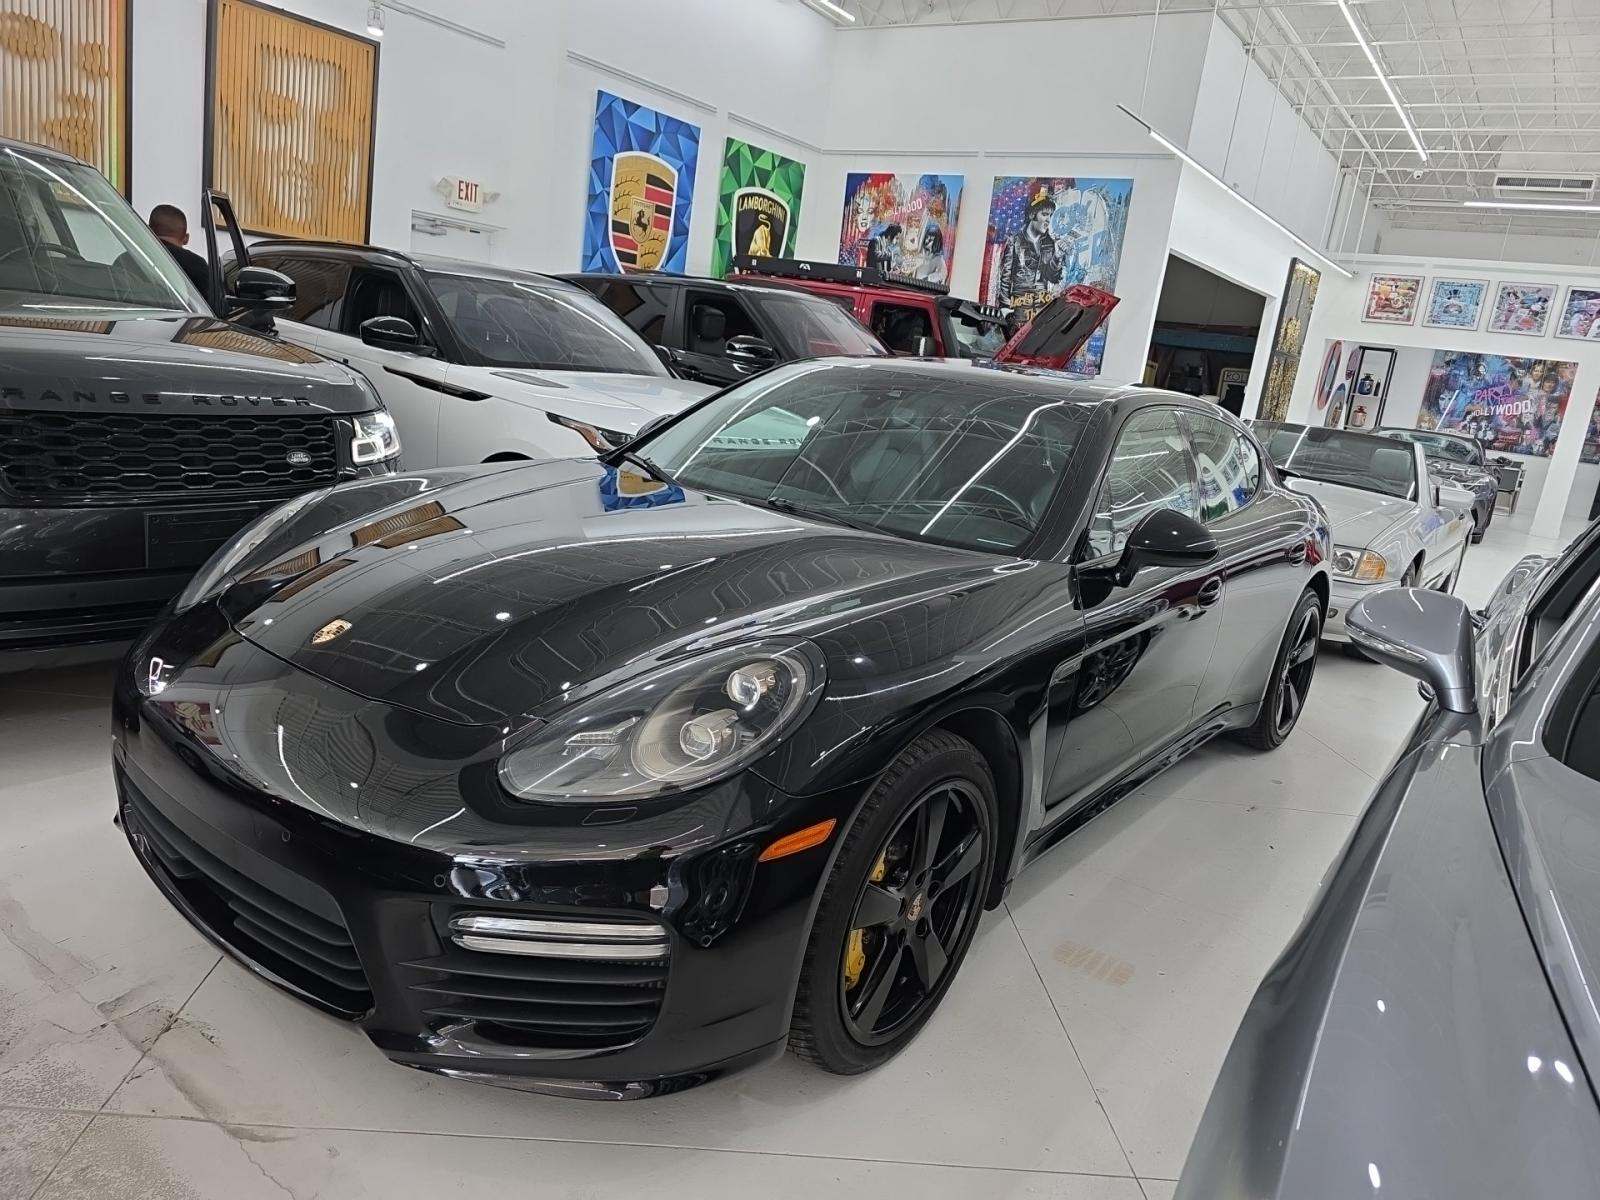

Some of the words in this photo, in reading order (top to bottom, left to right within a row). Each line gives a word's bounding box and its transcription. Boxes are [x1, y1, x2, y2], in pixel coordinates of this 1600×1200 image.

[458, 179, 479, 203] EXIT
[738, 195, 786, 222] LAMBORGHINI
[2, 387, 162, 404] RANGE
[192, 394, 311, 406] ROVER
[1472, 400, 1532, 417] HOLLYWOOD
